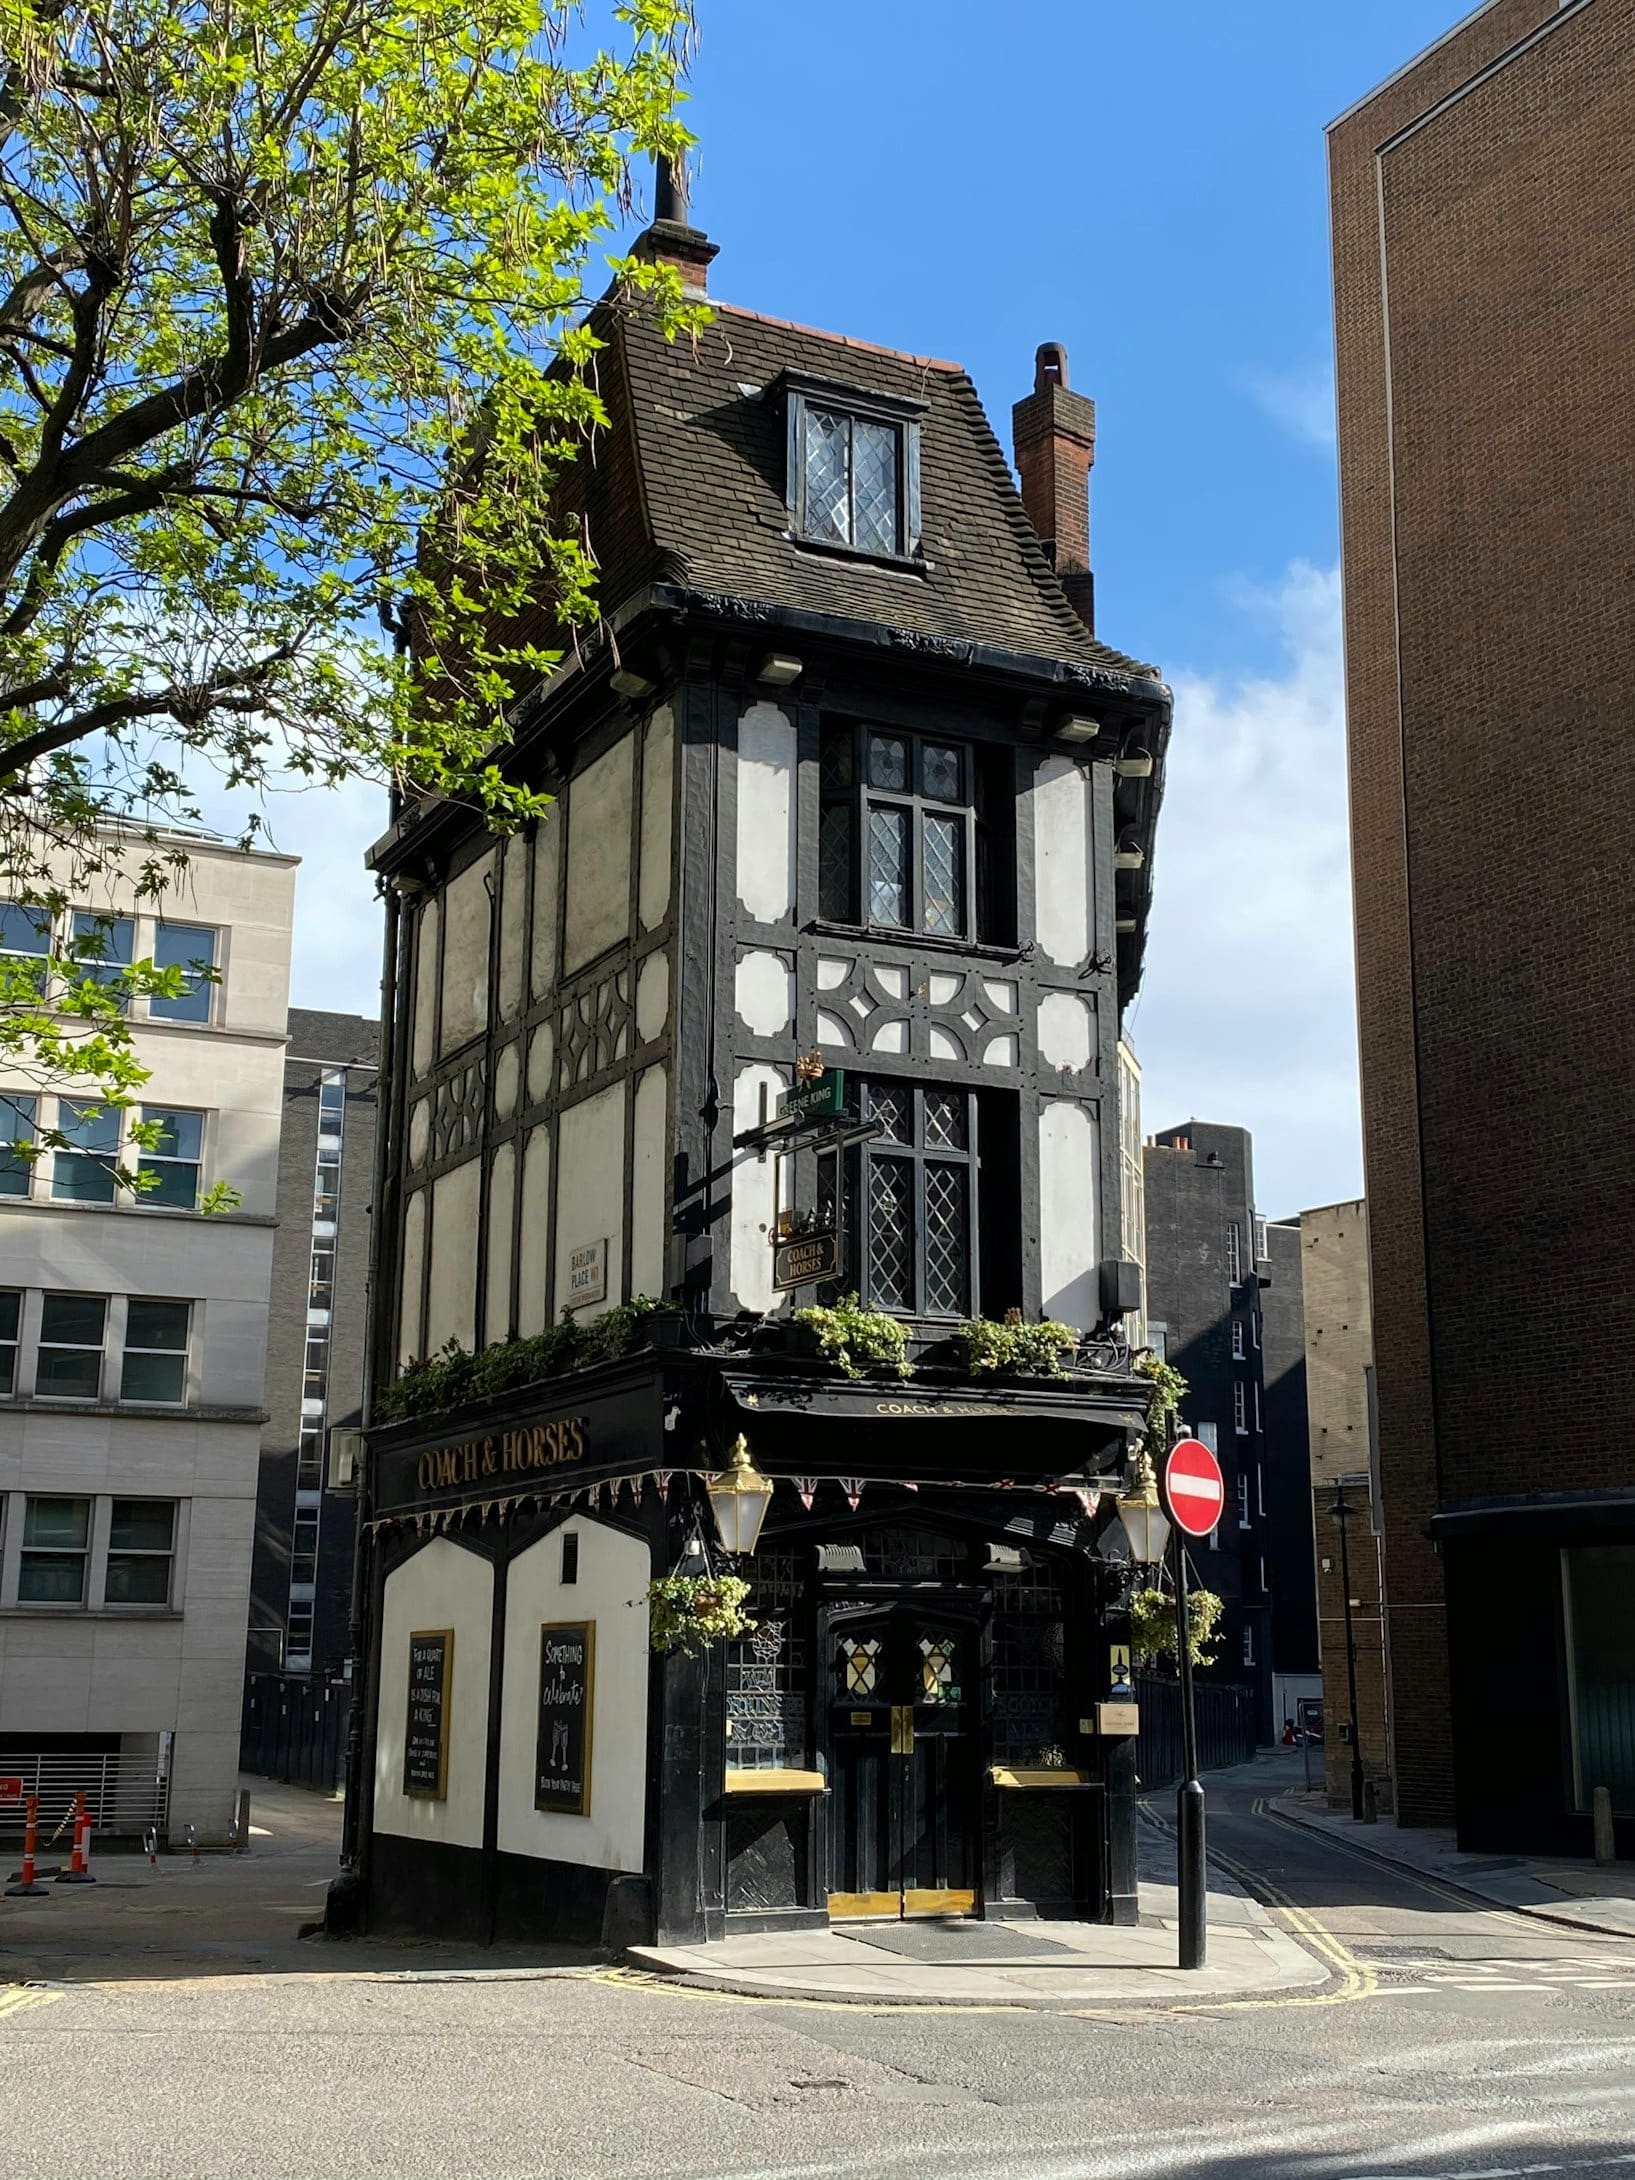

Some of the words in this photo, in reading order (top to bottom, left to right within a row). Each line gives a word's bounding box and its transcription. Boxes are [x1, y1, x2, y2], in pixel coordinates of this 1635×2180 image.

[779, 1095, 809, 1116] GREENE
[810, 1087, 831, 1105] KING
[571, 1248, 596, 1271] BARLOW
[787, 1244, 816, 1263] COACH
[817, 1242, 824, 1256] &
[790, 1257, 821, 1277] HORSES
[571, 1269, 588, 1289] PLACE
[877, 1403, 938, 1414] COACH
[942, 1405, 954, 1414] &
[418, 1440, 479, 1490] COACH
[482, 1432, 498, 1475] &
[502, 1416, 585, 1471] HORSES
